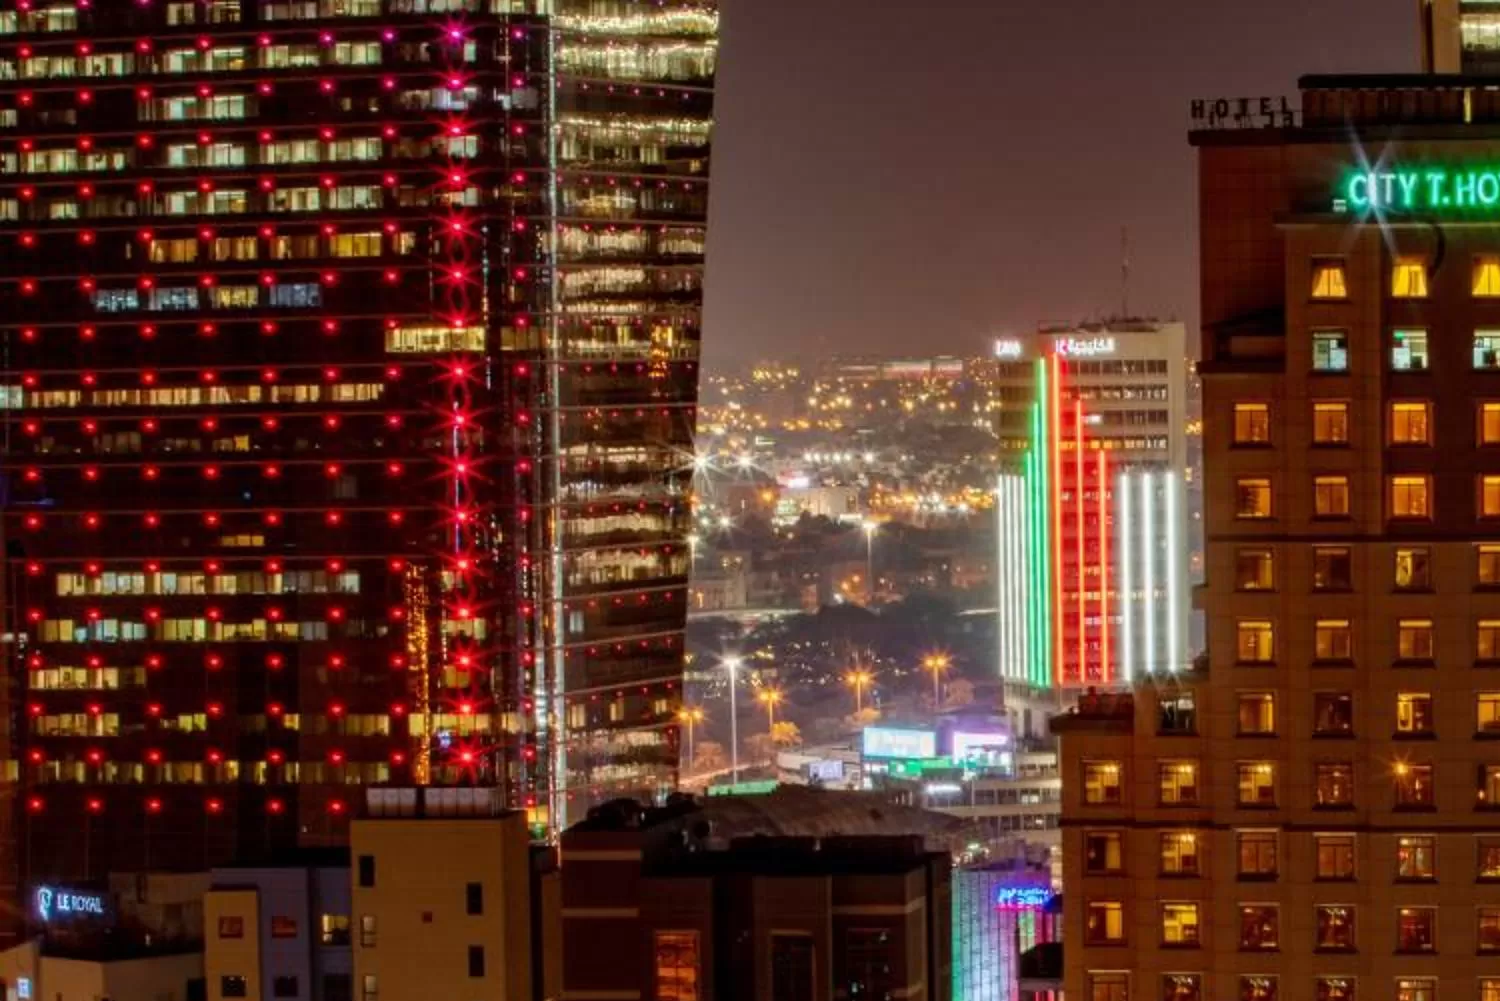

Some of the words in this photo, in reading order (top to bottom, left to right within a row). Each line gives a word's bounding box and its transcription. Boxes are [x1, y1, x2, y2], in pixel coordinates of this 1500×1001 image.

[1191, 96, 1294, 119] HOTEL
[1349, 172, 1418, 206] CITY
[1427, 172, 1450, 206] T.
[57, 893, 71, 911] LE
